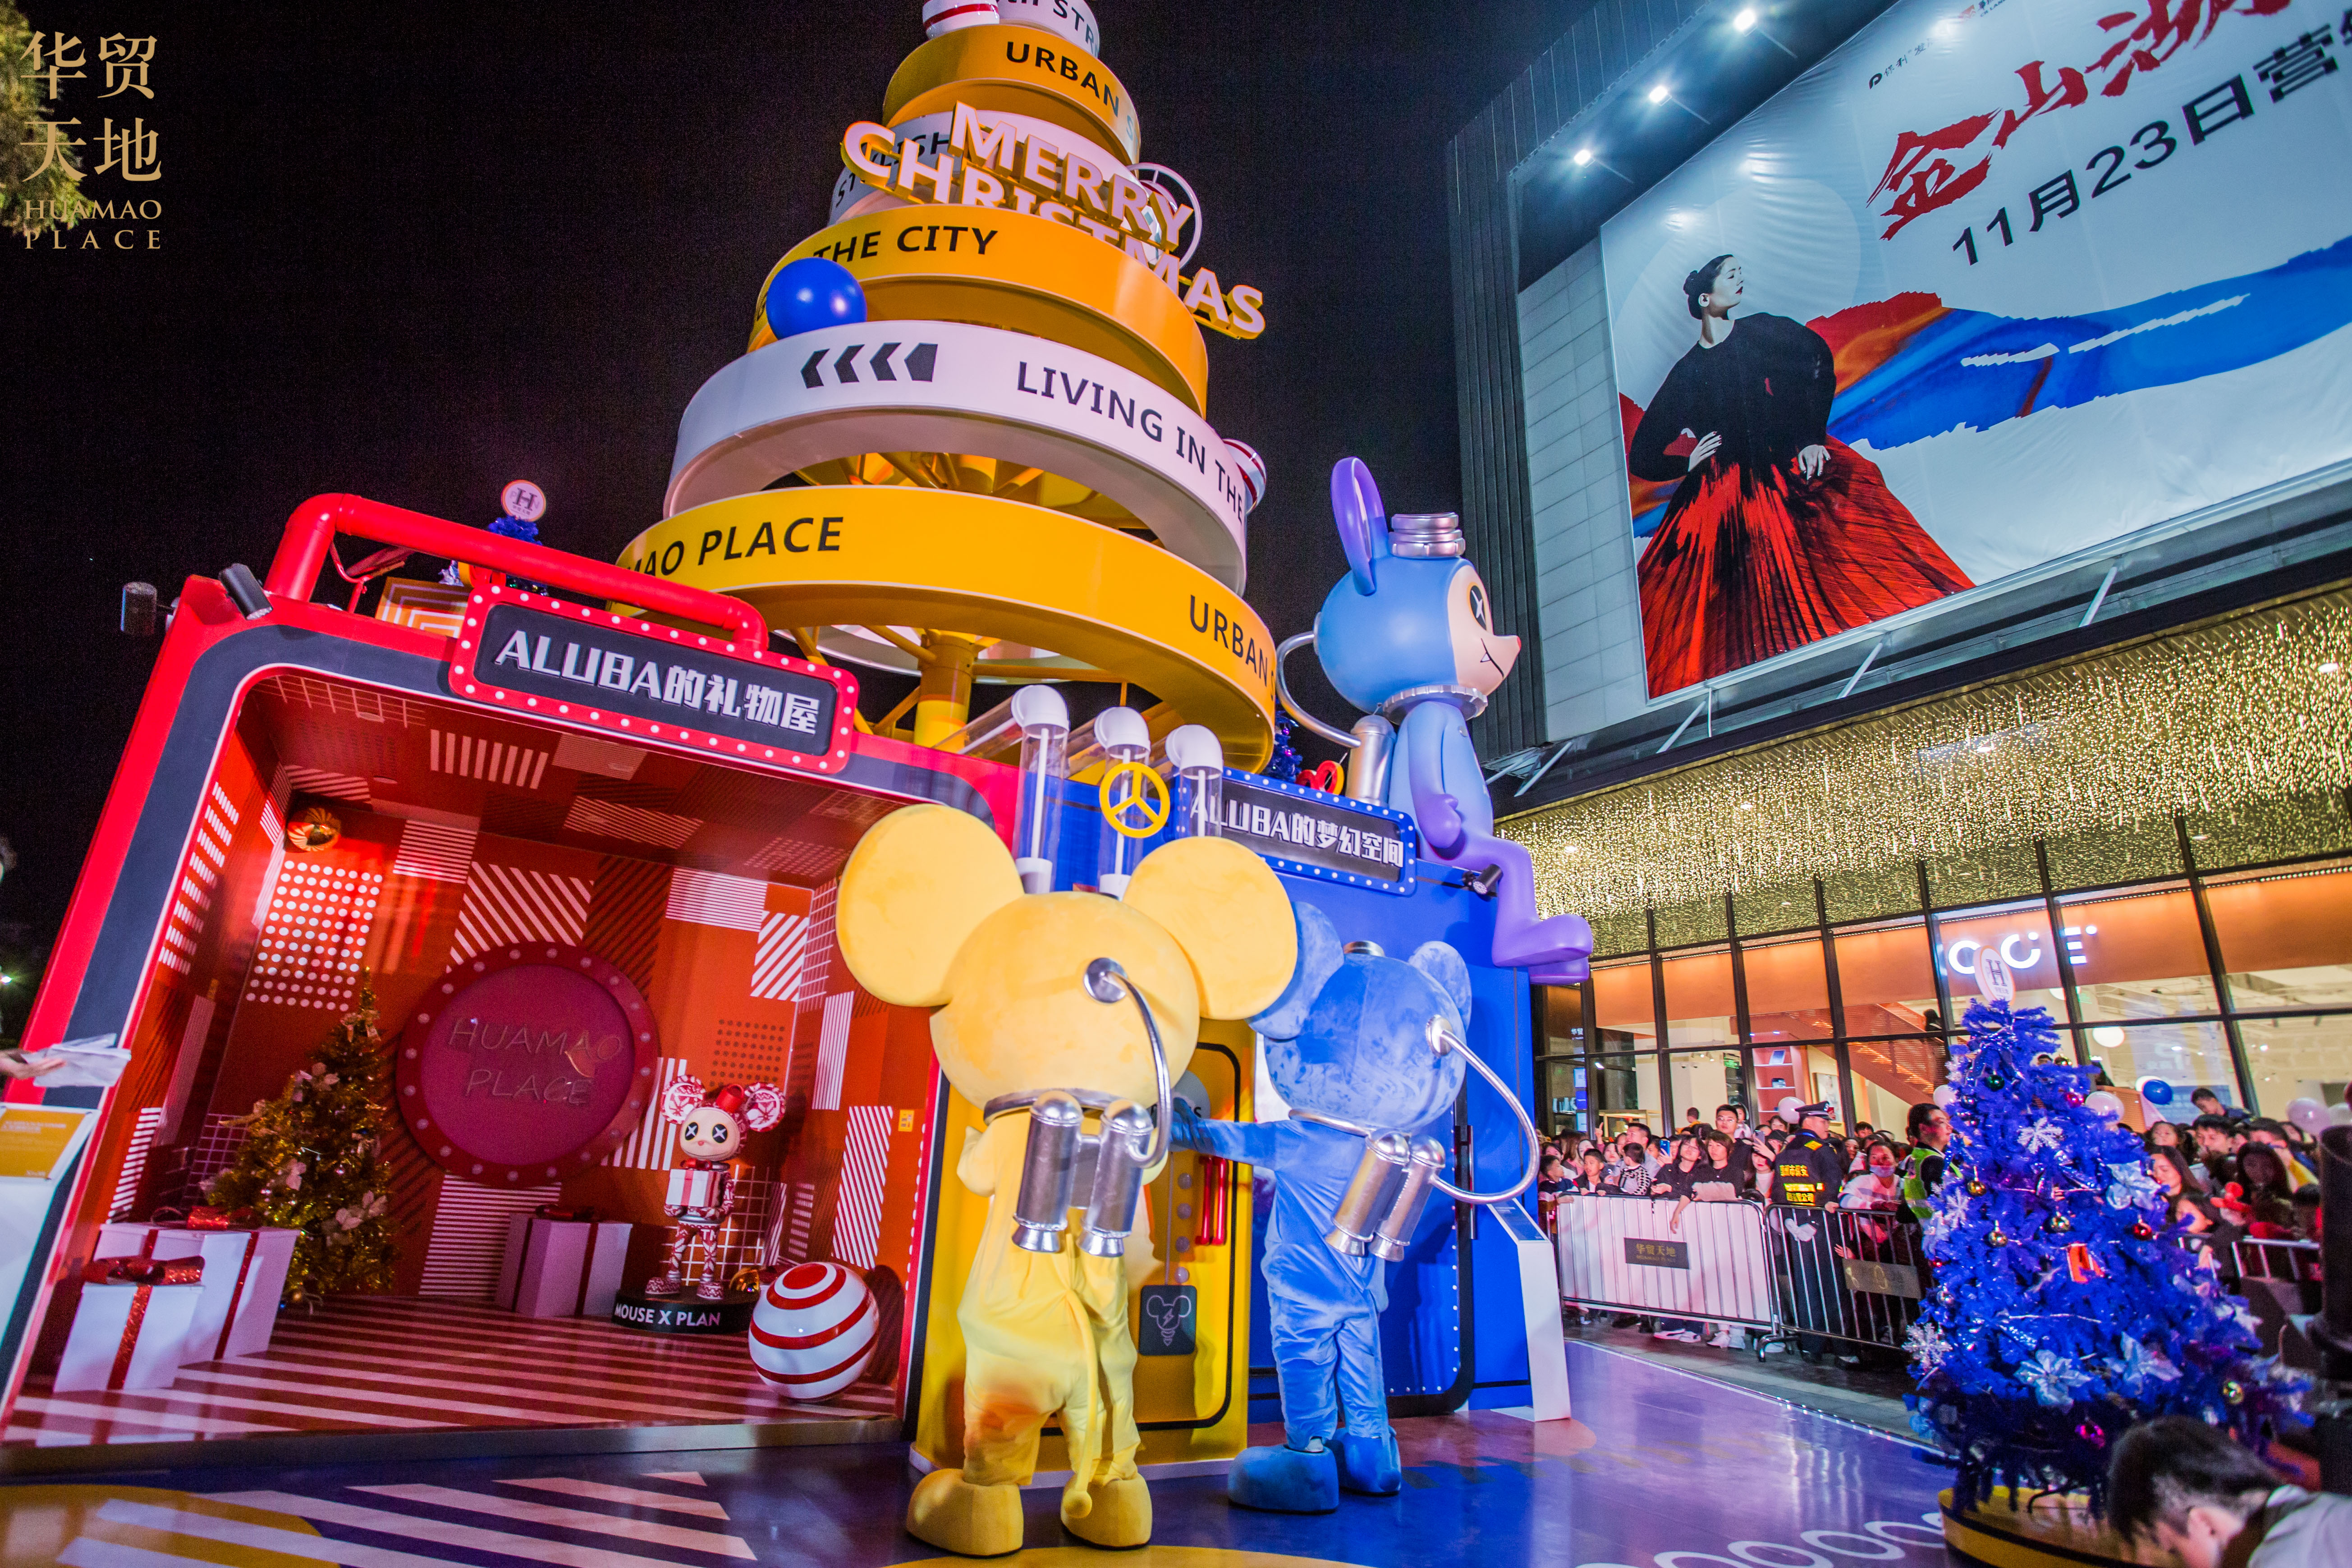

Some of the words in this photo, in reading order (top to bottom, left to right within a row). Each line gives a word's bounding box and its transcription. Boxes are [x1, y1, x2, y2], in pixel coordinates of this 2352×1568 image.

[1006, 41, 1119, 118] URBAN
[1952, 5, 2352, 266] 11月23日营
[948, 100, 1194, 252] MERRY
[897, 225, 998, 255] CITY
[1017, 361, 1162, 442] LIVING
[1176, 426, 1206, 475] IN
[1215, 458, 1243, 524] THE
[698, 517, 844, 566] PLACE
[1190, 595, 1268, 687] URBAN
[494, 629, 821, 735] ALUBA的礼物屋
[448, 1016, 624, 1060] HUAMAO
[465, 1068, 594, 1106] PLACE
[614, 1303, 655, 1324] MOUSE
[658, 1309, 672, 1325] X
